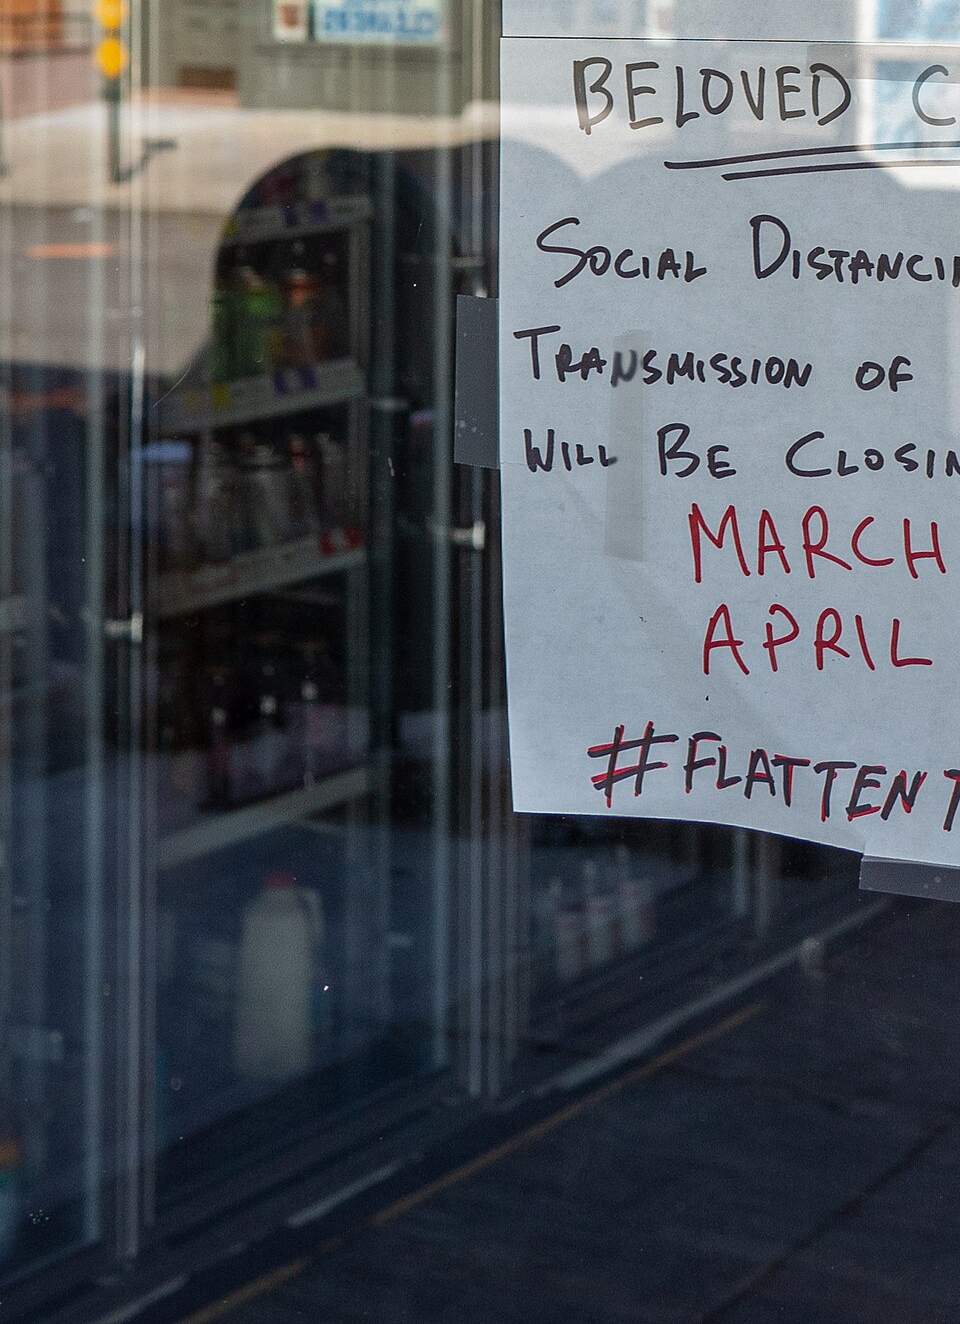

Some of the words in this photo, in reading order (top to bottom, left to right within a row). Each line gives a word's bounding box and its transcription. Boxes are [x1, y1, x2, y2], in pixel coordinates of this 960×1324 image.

[572, 56, 852, 136] BELOVED
[535, 216, 708, 289] SOCIAL
[512, 324, 813, 391] TRANSMISSION
[854, 355, 914, 393] OF
[522, 428, 618, 474] WILL
[656, 422, 737, 480] BE
[687, 502, 948, 585] MARCH
[702, 603, 935, 677] APRIL
